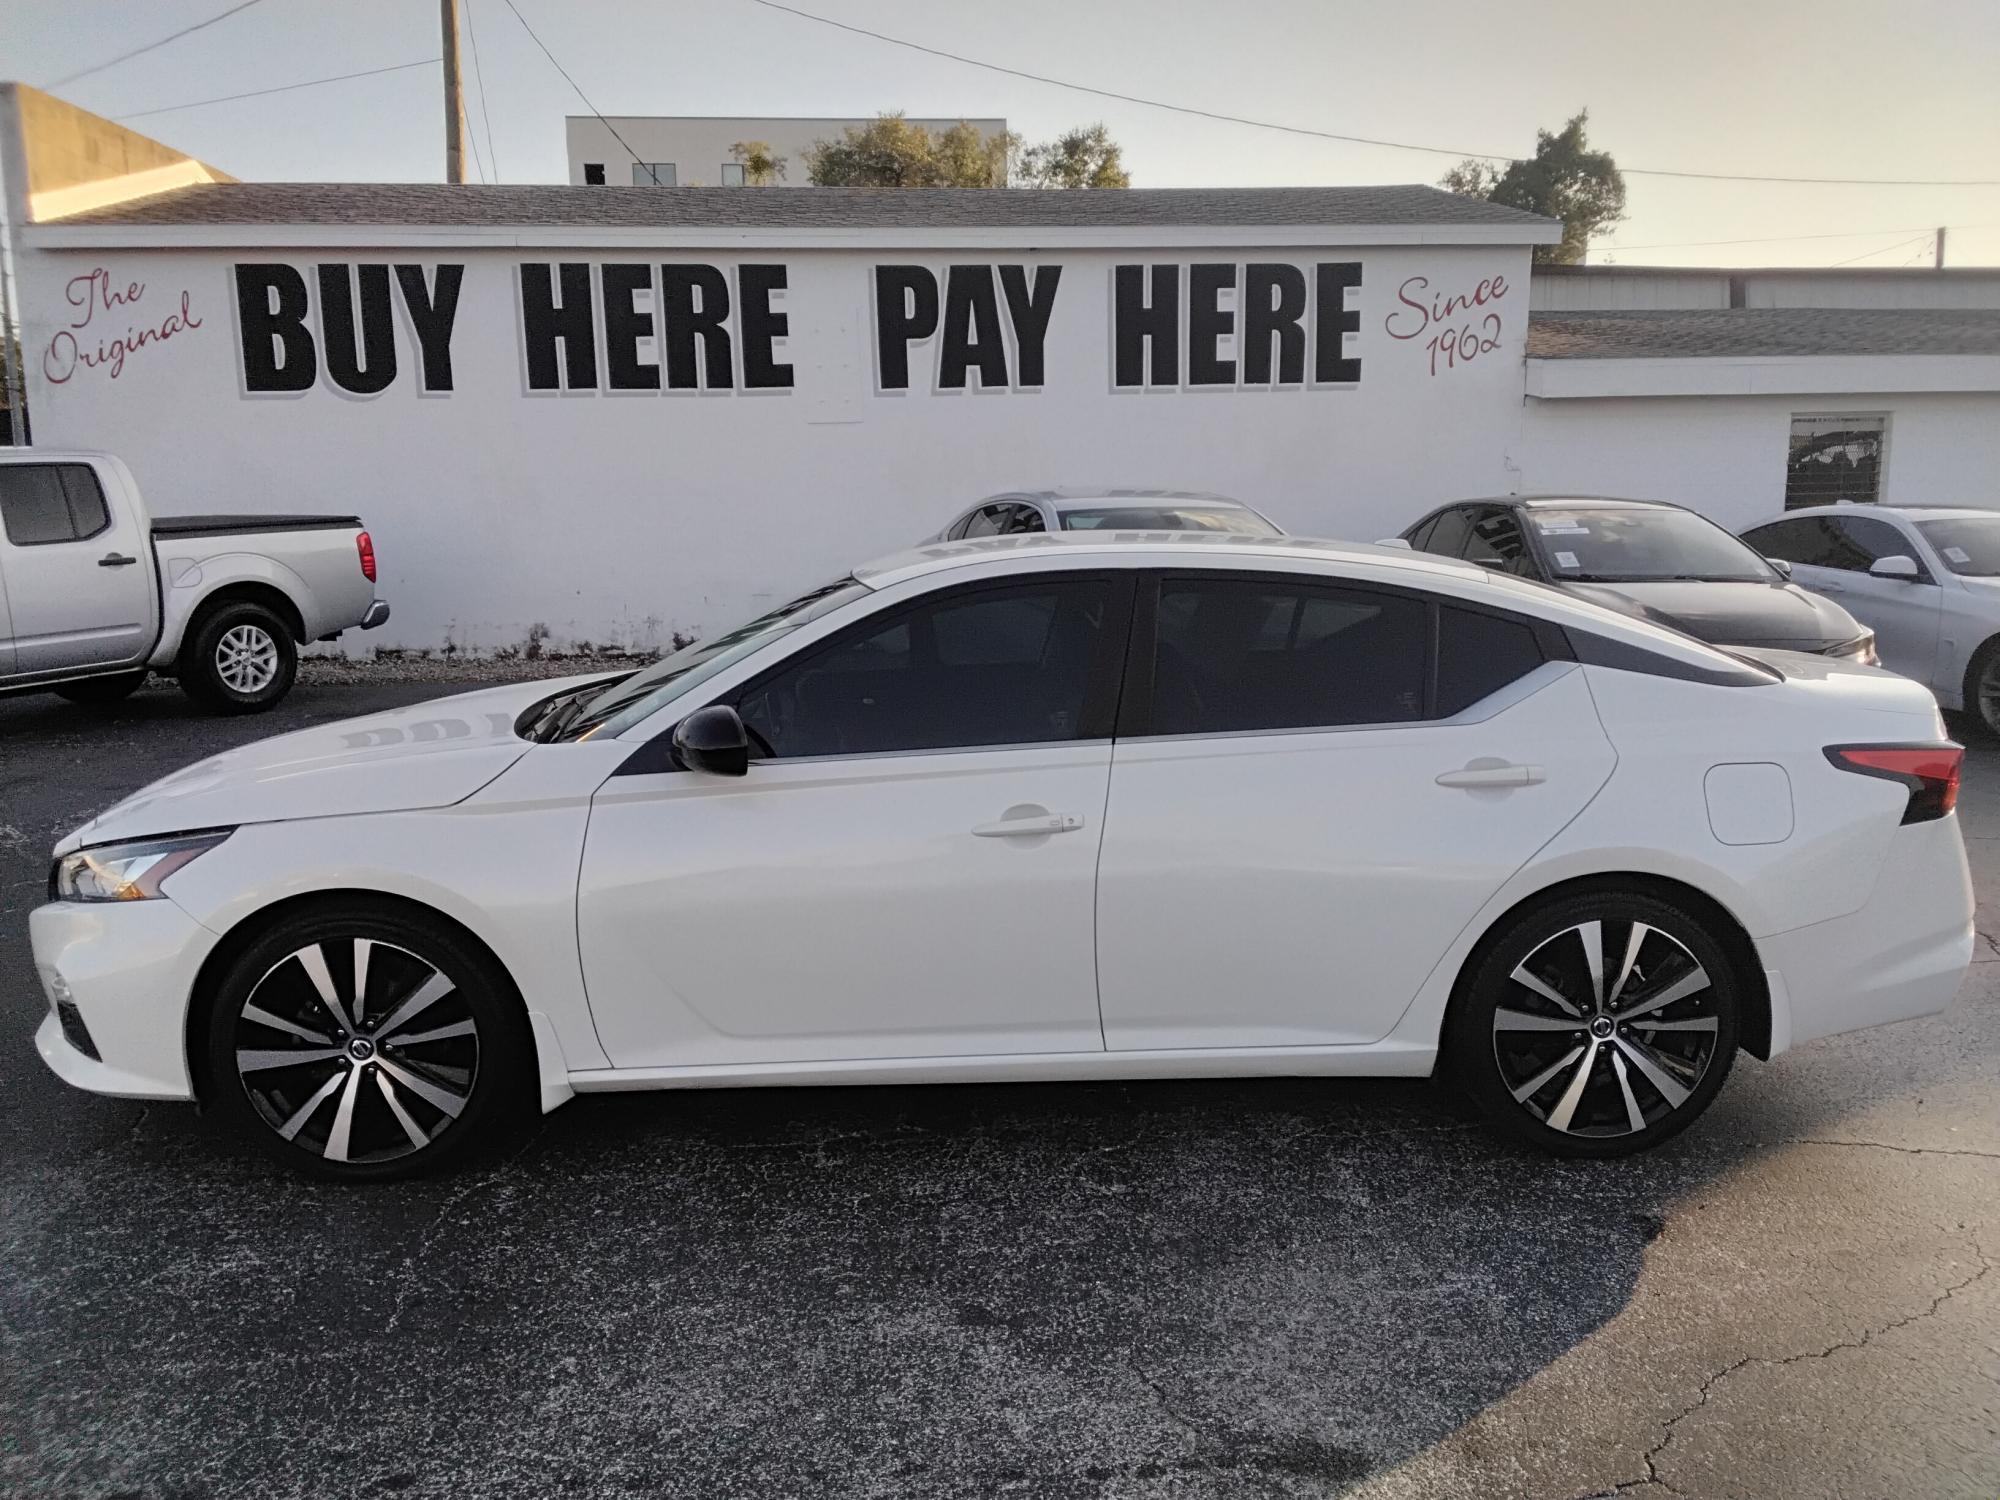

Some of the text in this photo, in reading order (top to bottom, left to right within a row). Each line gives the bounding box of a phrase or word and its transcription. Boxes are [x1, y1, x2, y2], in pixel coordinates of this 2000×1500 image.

[65, 268, 145, 329] The
[233, 262, 1363, 394] BUY HERE PAY HERE
[1384, 275, 1509, 340] Since
[43, 290, 203, 384] Original
[1426, 313, 1503, 377] 1962
